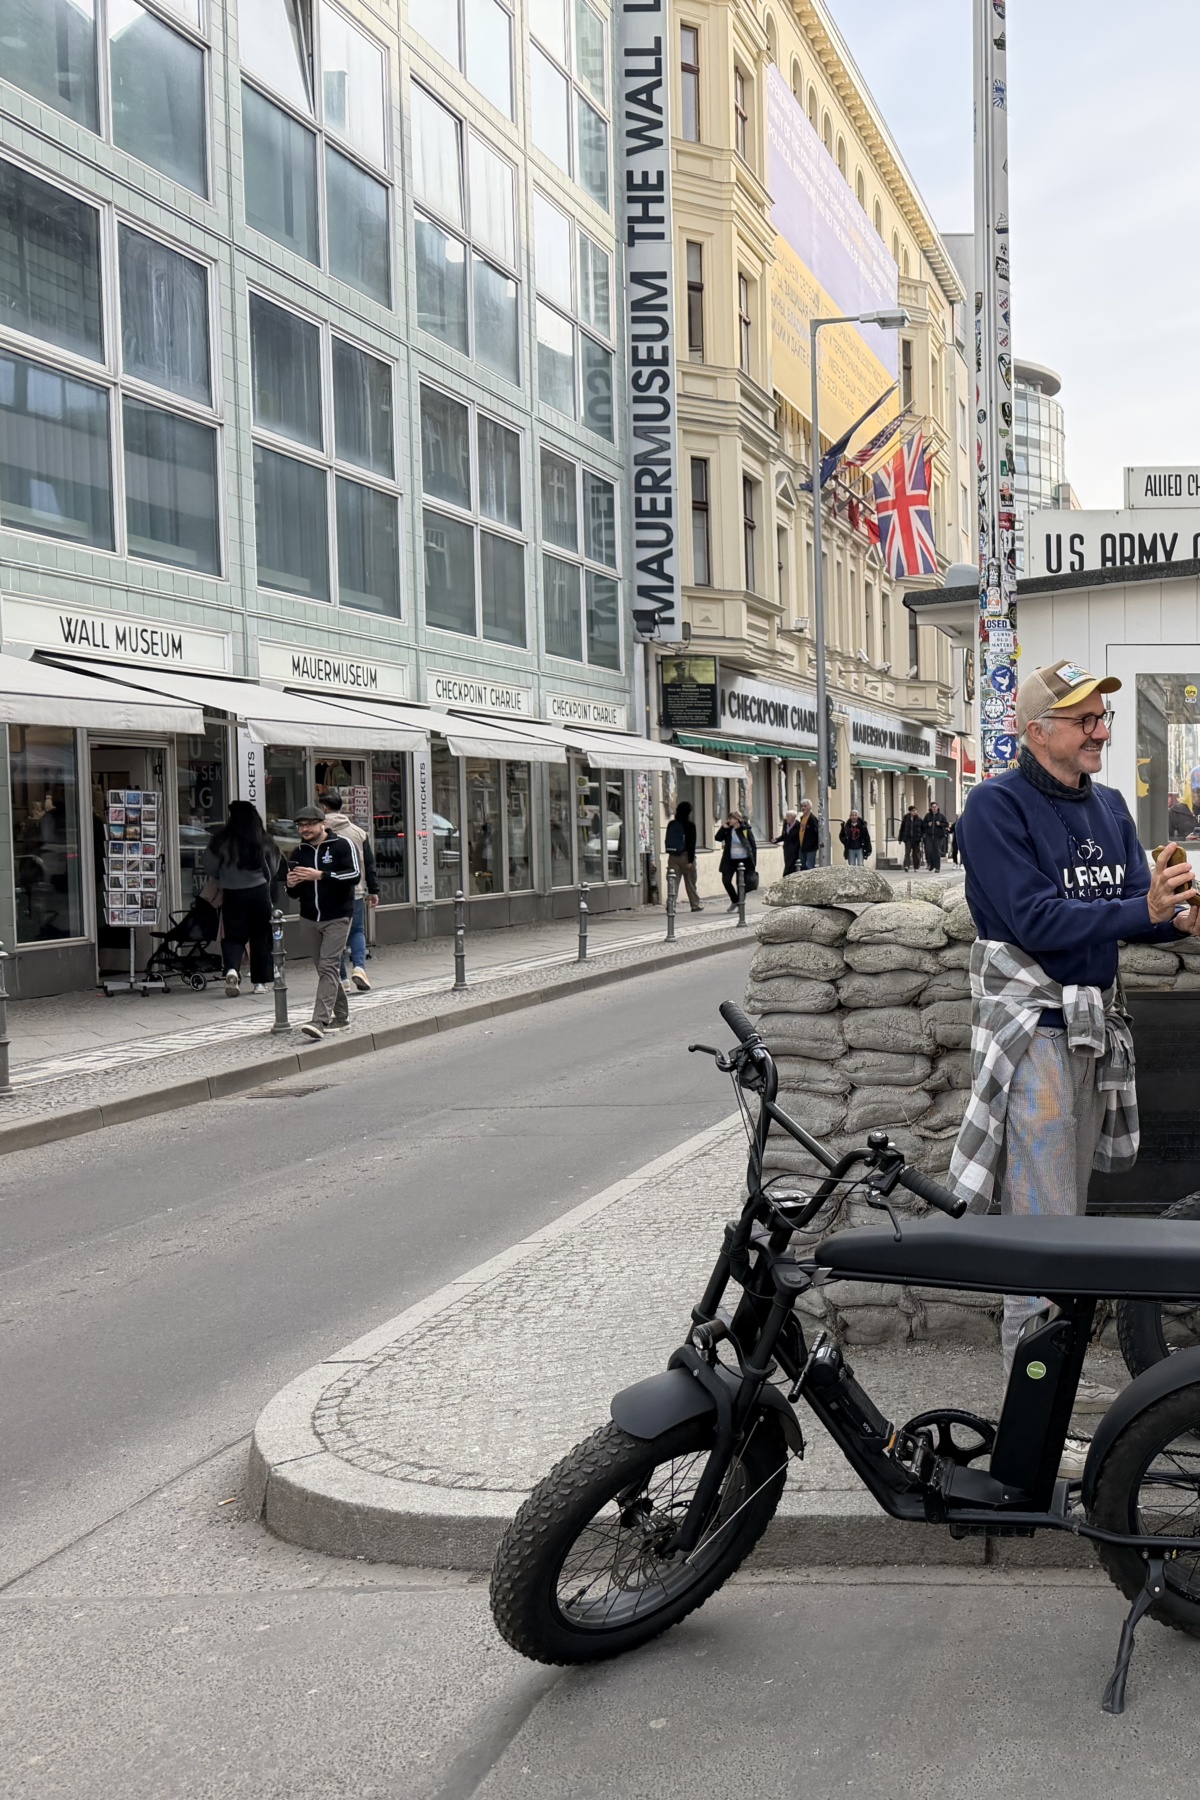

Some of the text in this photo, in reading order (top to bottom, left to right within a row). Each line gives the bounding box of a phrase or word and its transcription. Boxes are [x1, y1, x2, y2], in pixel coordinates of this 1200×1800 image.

[624, 36, 663, 157] WALL
[627, 170, 665, 247] THE
[630, 271, 675, 625] MAUERMUSEUM
[1144, 473, 1182, 497] ALLIED
[1045, 532, 1085, 574] US
[1100, 531, 1179, 567] ARMY
[59, 616, 183, 660] WALL MUSEUM
[986, 619, 1008, 629] OSED
[291, 655, 378, 689] MAUERMUSEUM
[435, 678, 522, 711] CHECKPOINT CHARLIE
[552, 699, 617, 725] CHECKPOINT CHARLIE
[728, 690, 789, 729] CHECKPOINT
[248, 750, 257, 803] ICKETS
[420, 762, 429, 866] MUSEUMTICKETS
[1063, 864, 1126, 889] URBAN
